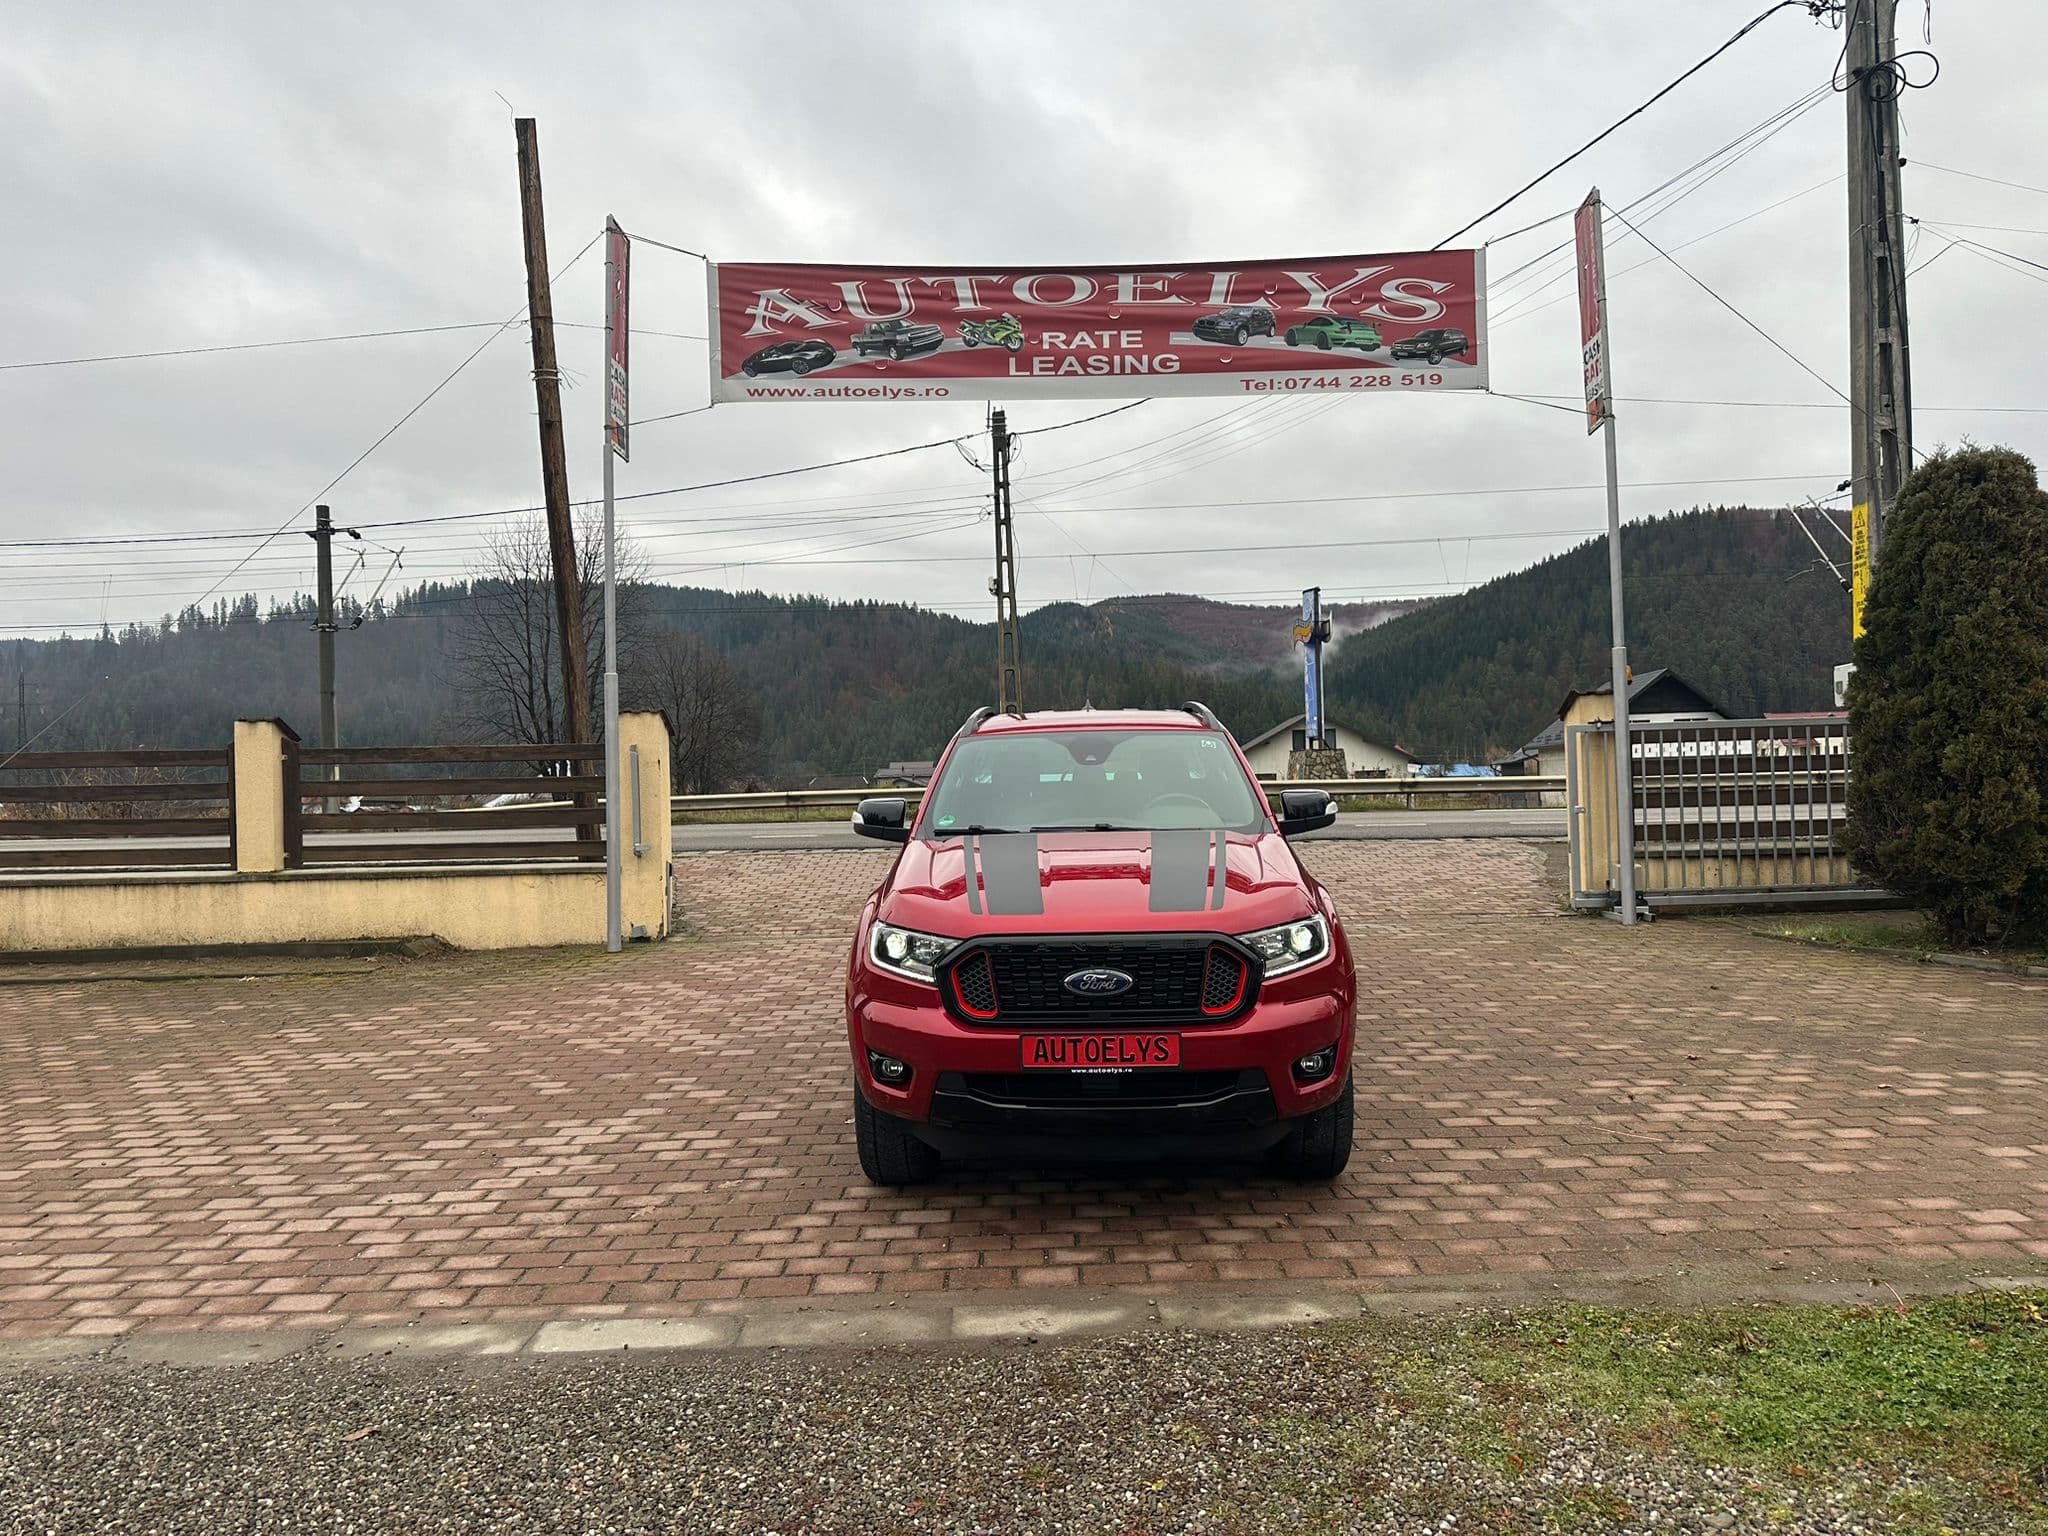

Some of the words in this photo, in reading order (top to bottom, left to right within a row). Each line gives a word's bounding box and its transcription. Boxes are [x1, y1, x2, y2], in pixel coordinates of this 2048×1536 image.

[742, 265, 1456, 338] AUTOELYS
[1042, 329, 1143, 350] RATE
[1008, 354, 1181, 376] LEASING
[746, 384, 950, 400] www.autoelys.ro
[1240, 377, 1341, 392] Tel:0744
[1349, 374, 1393, 389] 228
[1400, 372, 1444, 387] 519
[1079, 973, 1117, 990] Ford
[1033, 1037, 1169, 1064] AUTOELYS
